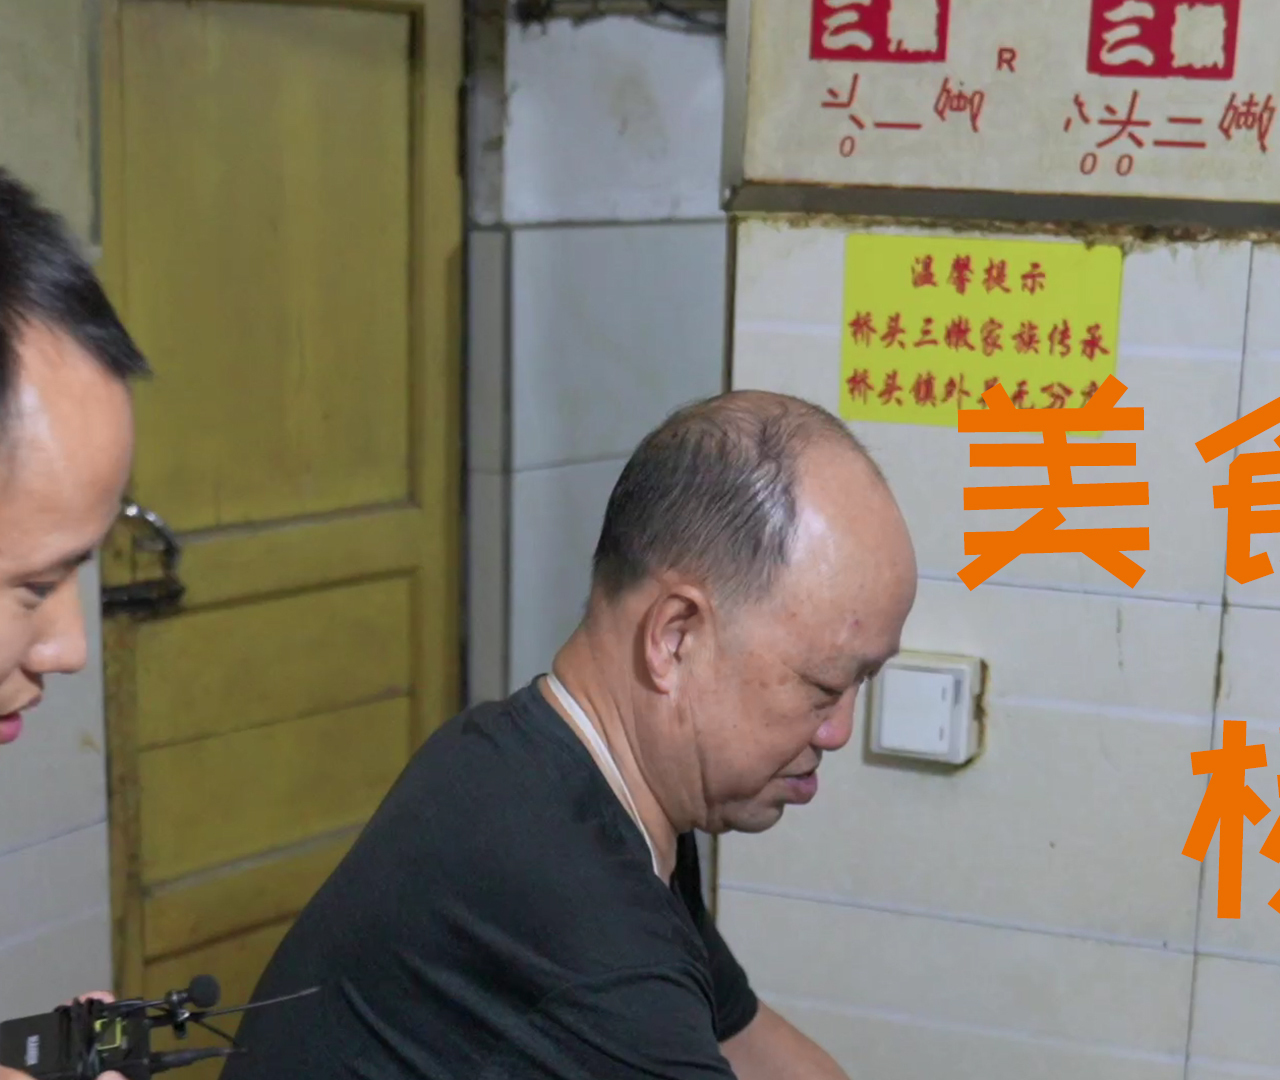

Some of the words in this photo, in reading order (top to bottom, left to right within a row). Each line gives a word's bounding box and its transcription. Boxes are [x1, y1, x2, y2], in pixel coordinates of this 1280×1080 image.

[823, 0, 939, 51] 三
[1100, 0, 1226, 68] 三
[911, 254, 1048, 296] 温馨提示
[847, 310, 1112, 362] 桥头三嫩家族传承
